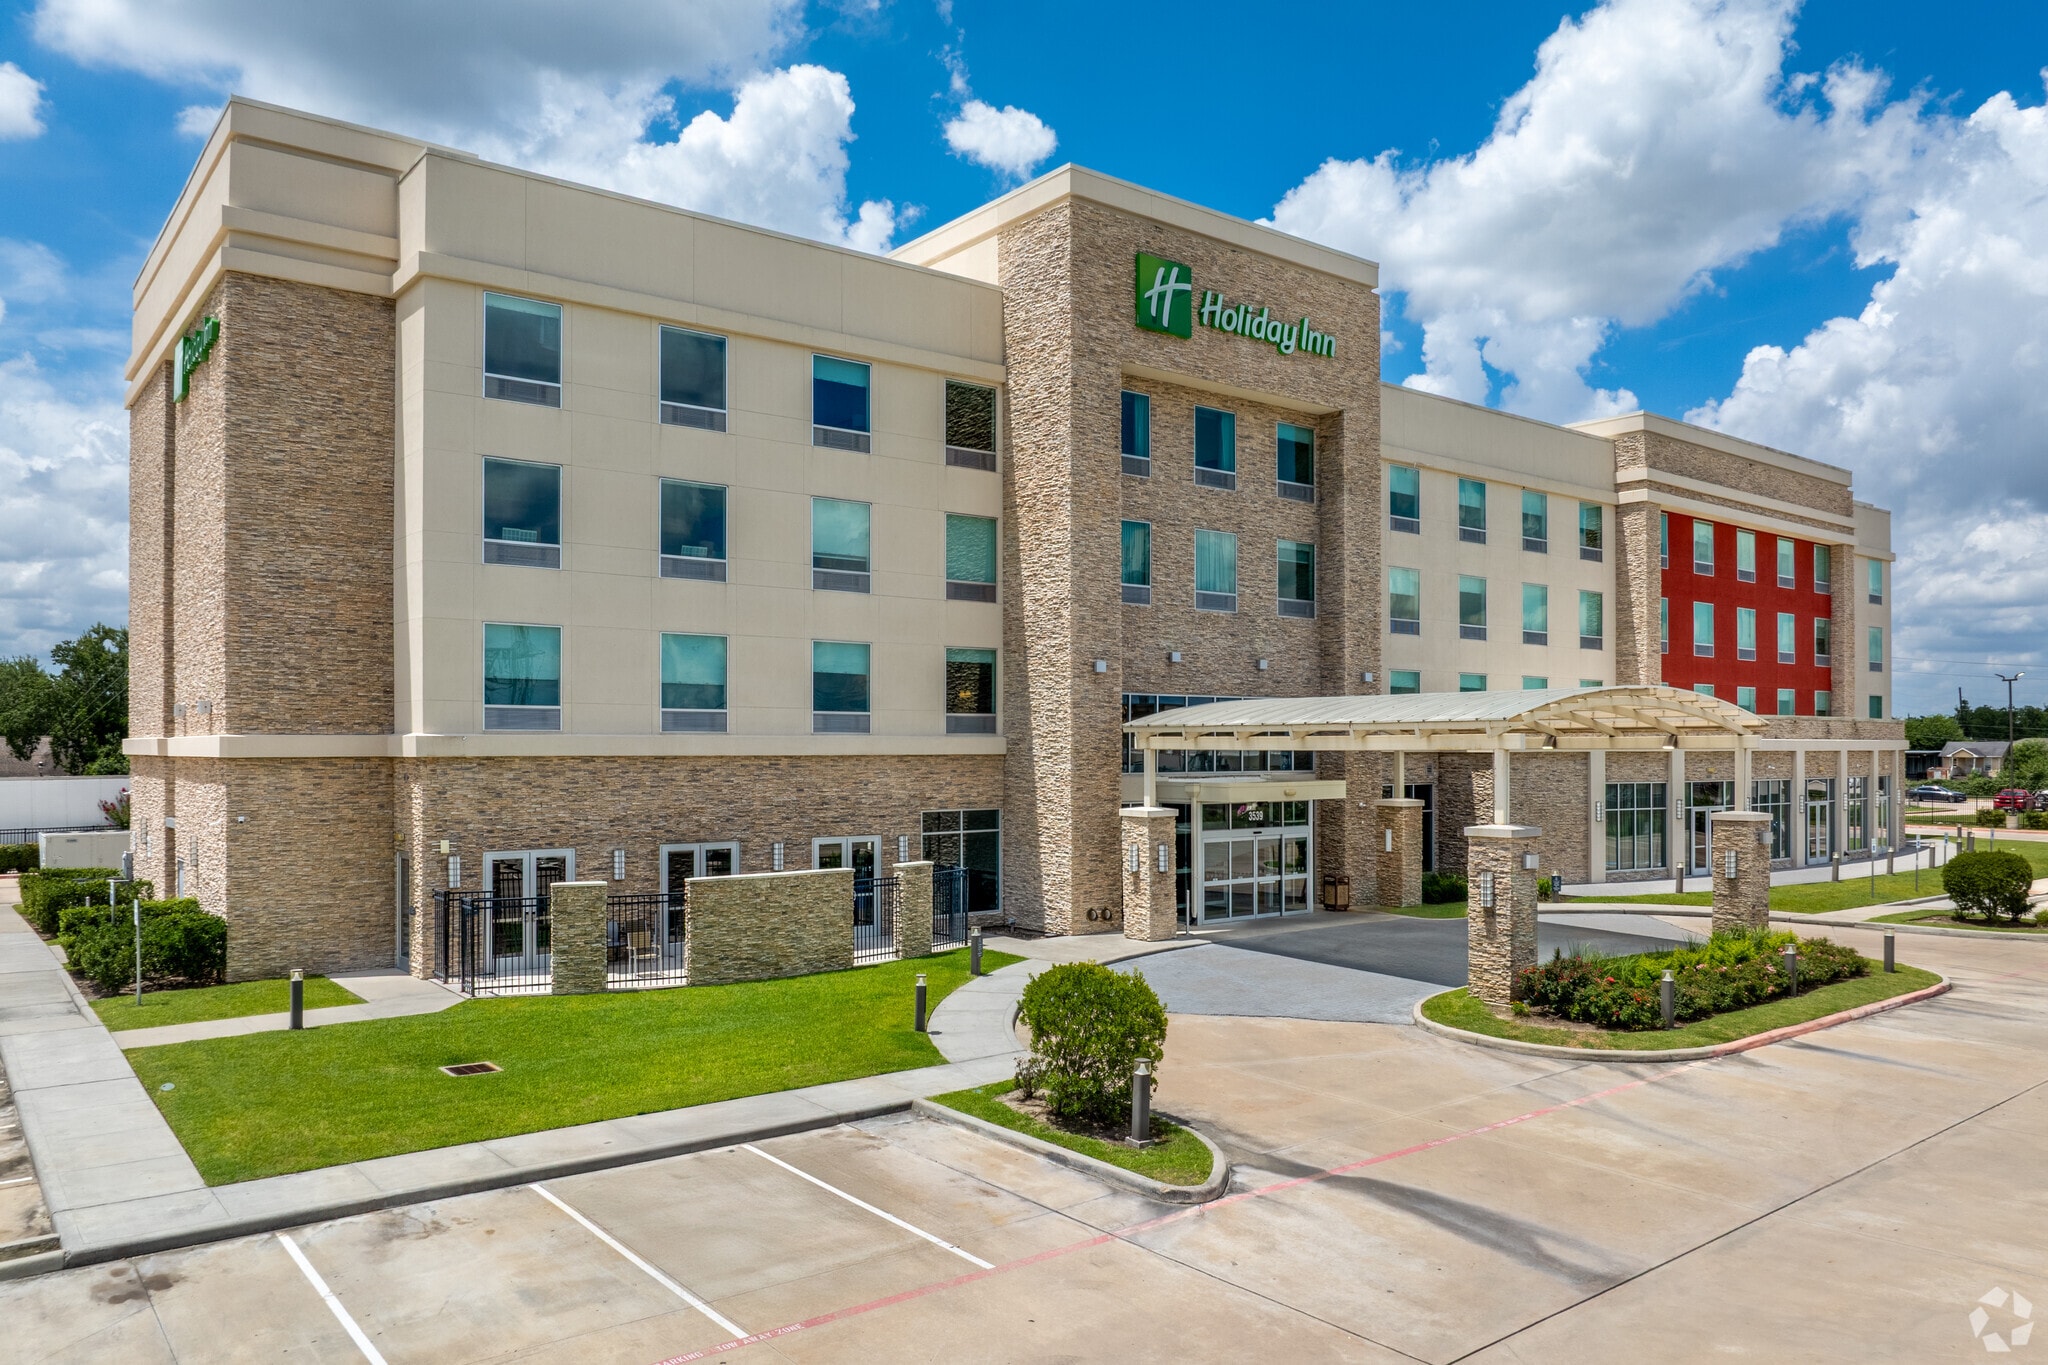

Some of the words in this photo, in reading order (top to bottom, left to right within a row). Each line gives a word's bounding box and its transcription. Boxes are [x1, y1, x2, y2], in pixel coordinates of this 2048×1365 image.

[1199, 290, 1298, 355] Holiday
[1298, 316, 1336, 358] Inn
[1248, 811, 1263, 821] 3539
[653, 1351, 704, 1365] ARKING
[716, 1342, 738, 1352] TOW
[743, 1331, 773, 1345] AWAY
